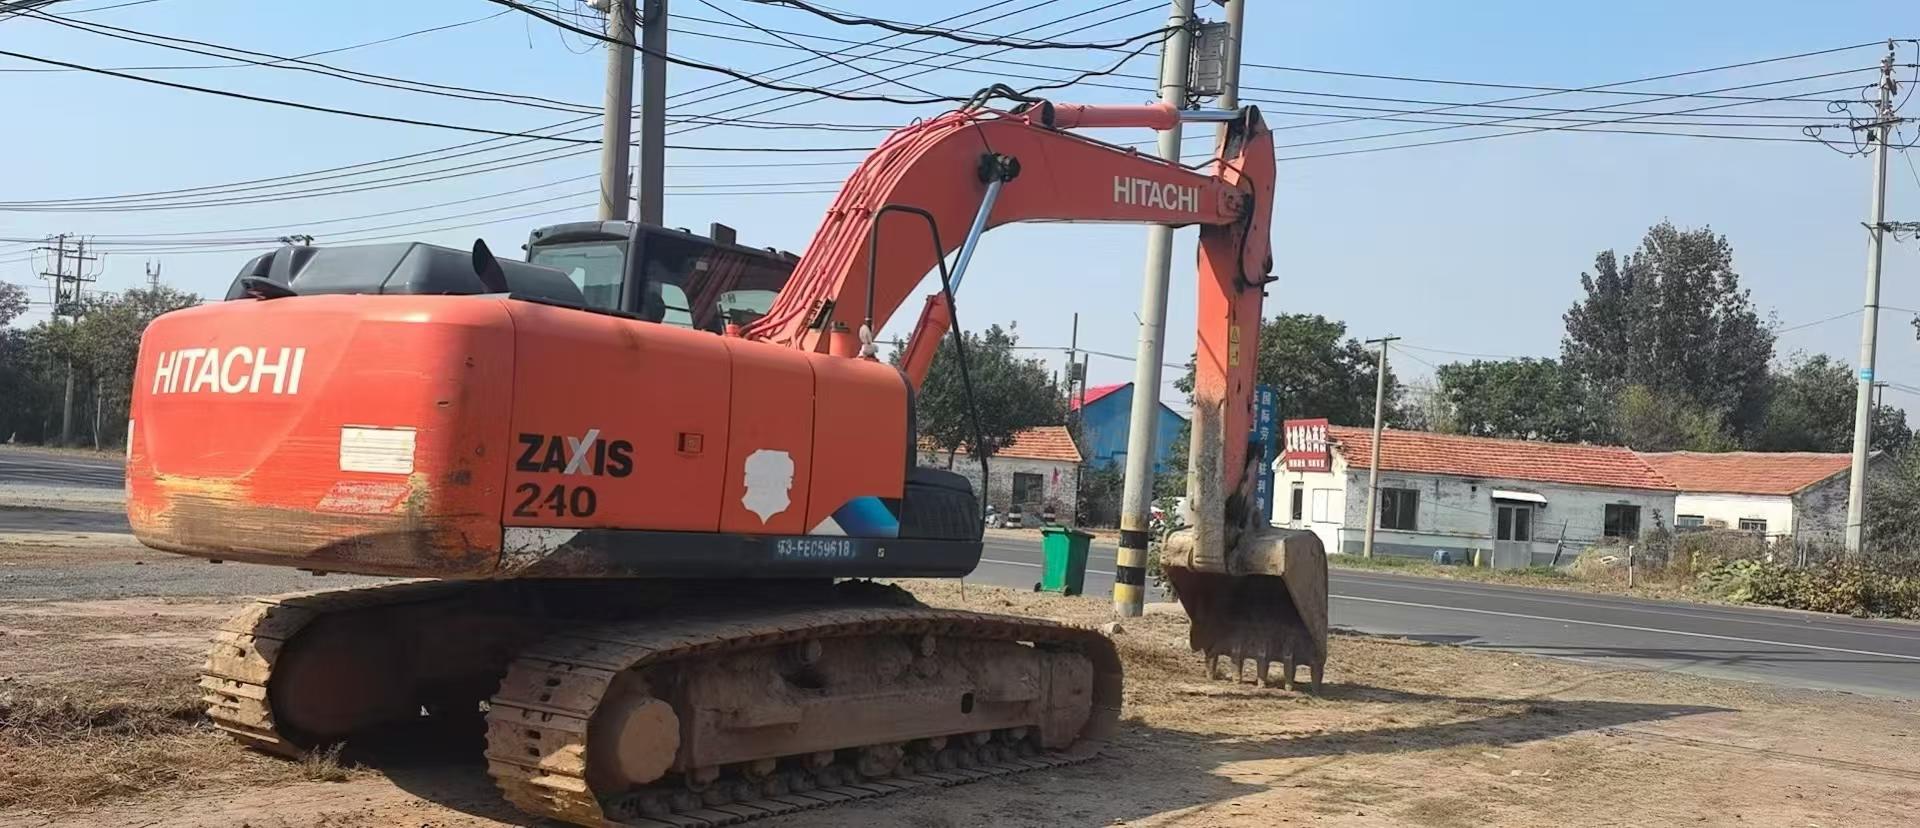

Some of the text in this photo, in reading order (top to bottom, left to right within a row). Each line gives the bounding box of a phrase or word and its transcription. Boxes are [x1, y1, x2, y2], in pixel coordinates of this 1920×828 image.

[1114, 175, 1198, 213] HITACHI
[152, 346, 305, 395] HITACHI
[516, 428, 634, 478] ZAXIS
[512, 482, 597, 518] 240
